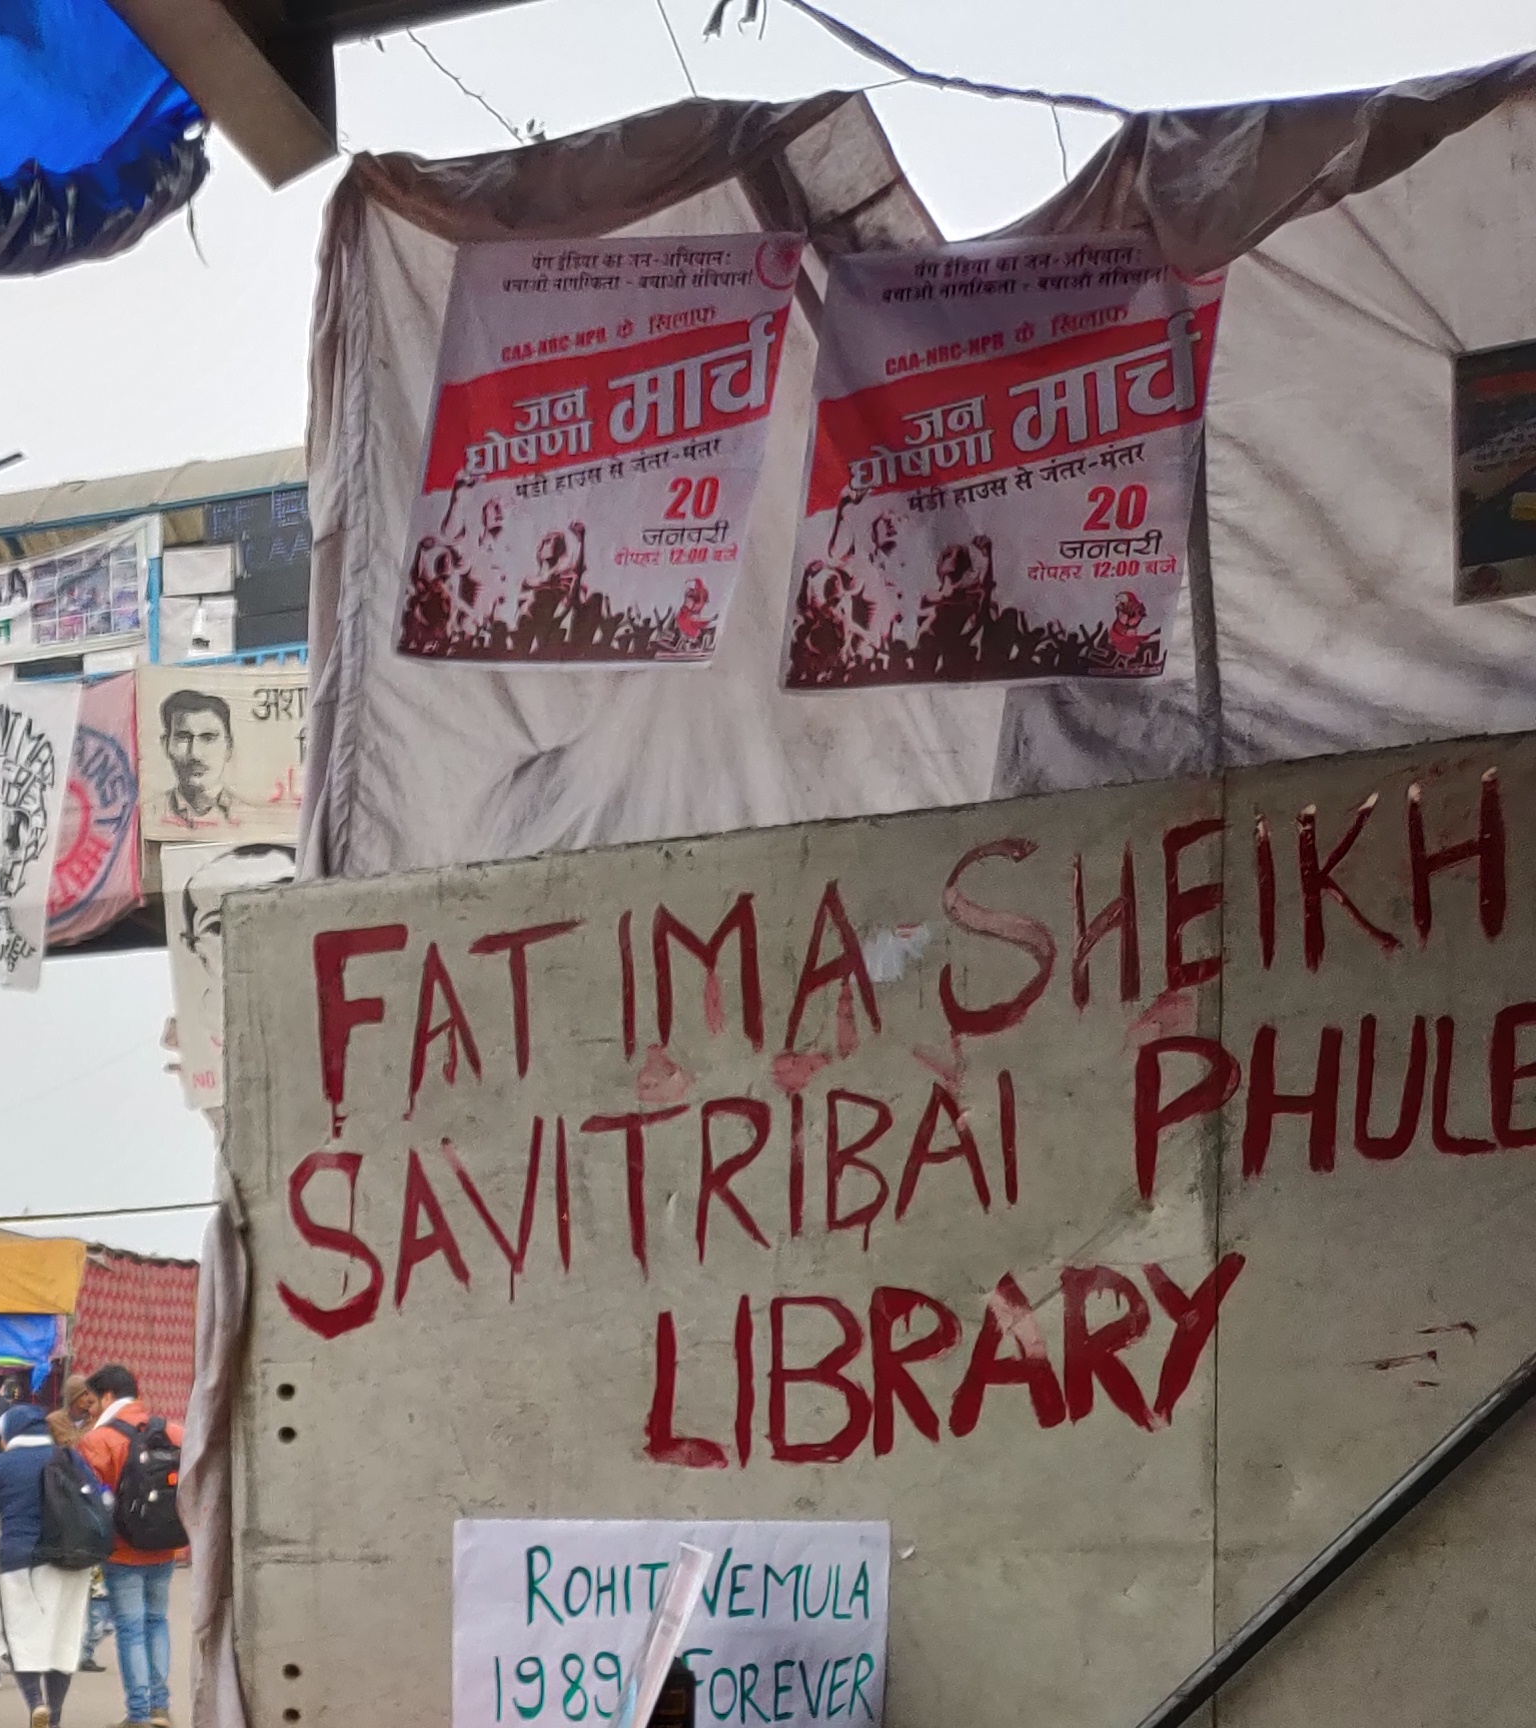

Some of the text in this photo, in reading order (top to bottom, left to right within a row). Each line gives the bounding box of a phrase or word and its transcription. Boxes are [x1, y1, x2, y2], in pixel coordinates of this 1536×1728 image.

[513, 312, 777, 445] जन मार्च
[884, 330, 1004, 376] CAA-NRC-NPR
[901, 308, 1202, 455] जन मार्च
[465, 420, 594, 476] घोषणा
[848, 427, 995, 491] घोषणा
[952, 475, 1009, 507] हाउस
[1014, 466, 1035, 492] से
[1040, 441, 1148, 486] जंतर-मंतर
[663, 475, 720, 521] 20
[1082, 484, 1150, 532] 20
[642, 519, 730, 546] जनवरी
[1058, 529, 1164, 560] जनवरी
[1027, 553, 1178, 582] दोपहर 12:00 बजे
[312, 772, 1510, 1108] FATIMA SHEIKH
[276, 1002, 1536, 1338] SAVITRIBAI PHULE
[644, 1252, 1248, 1468] LIBRARY
[525, 1545, 870, 1626] ROHIT VEMULA
[493, 1648, 874, 1725] 1989 FOREVER
